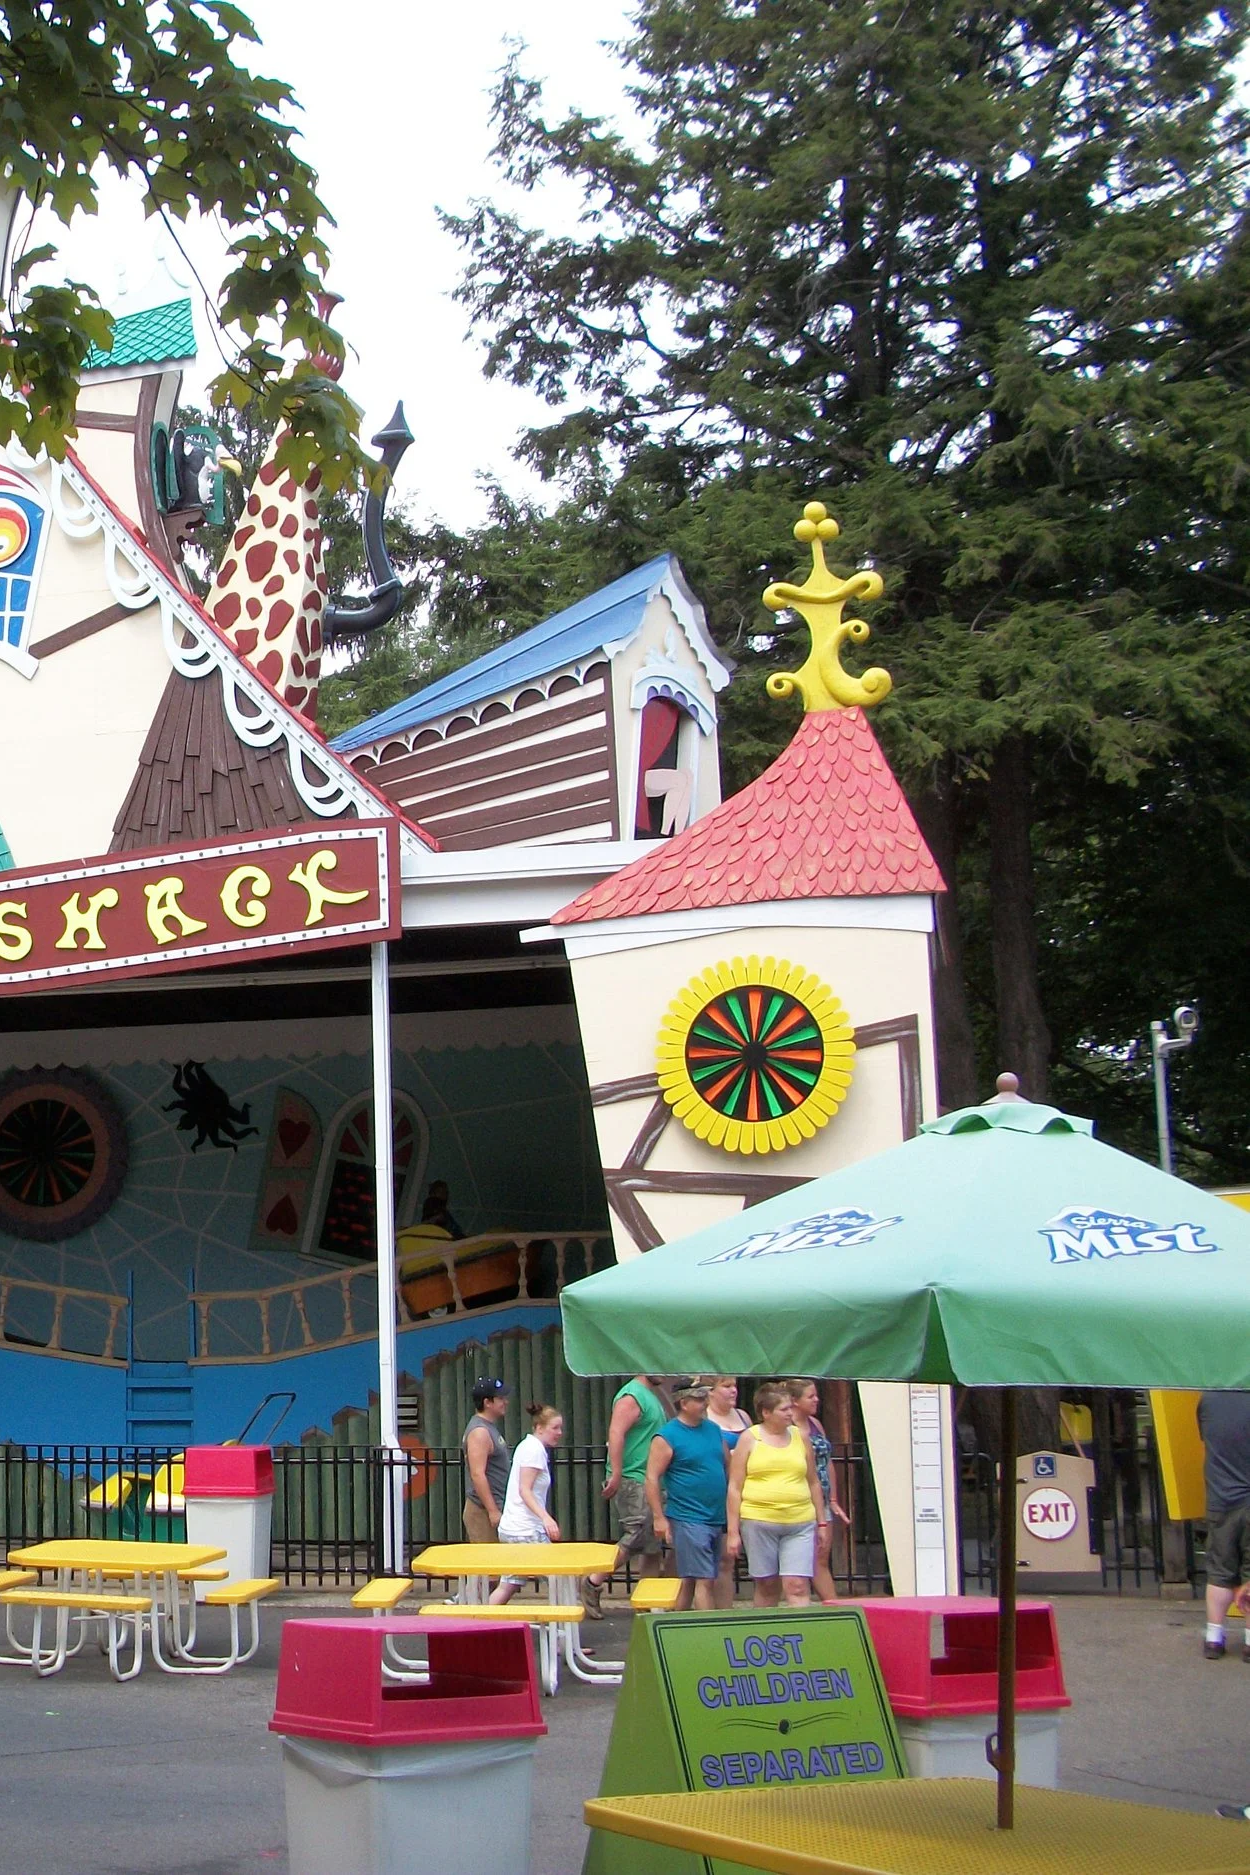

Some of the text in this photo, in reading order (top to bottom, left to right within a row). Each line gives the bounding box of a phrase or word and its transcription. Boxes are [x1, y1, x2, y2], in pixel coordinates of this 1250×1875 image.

[698, 1216, 903, 1265] Mist
[1070, 1215, 1150, 1230] Sierra
[1039, 1223, 1217, 1264] Mist
[1028, 1502, 1071, 1523] EXIT
[724, 1633, 803, 1668] LOST
[697, 1668, 854, 1709] CHILDREN
[700, 1741, 885, 1788] SEPARATED
